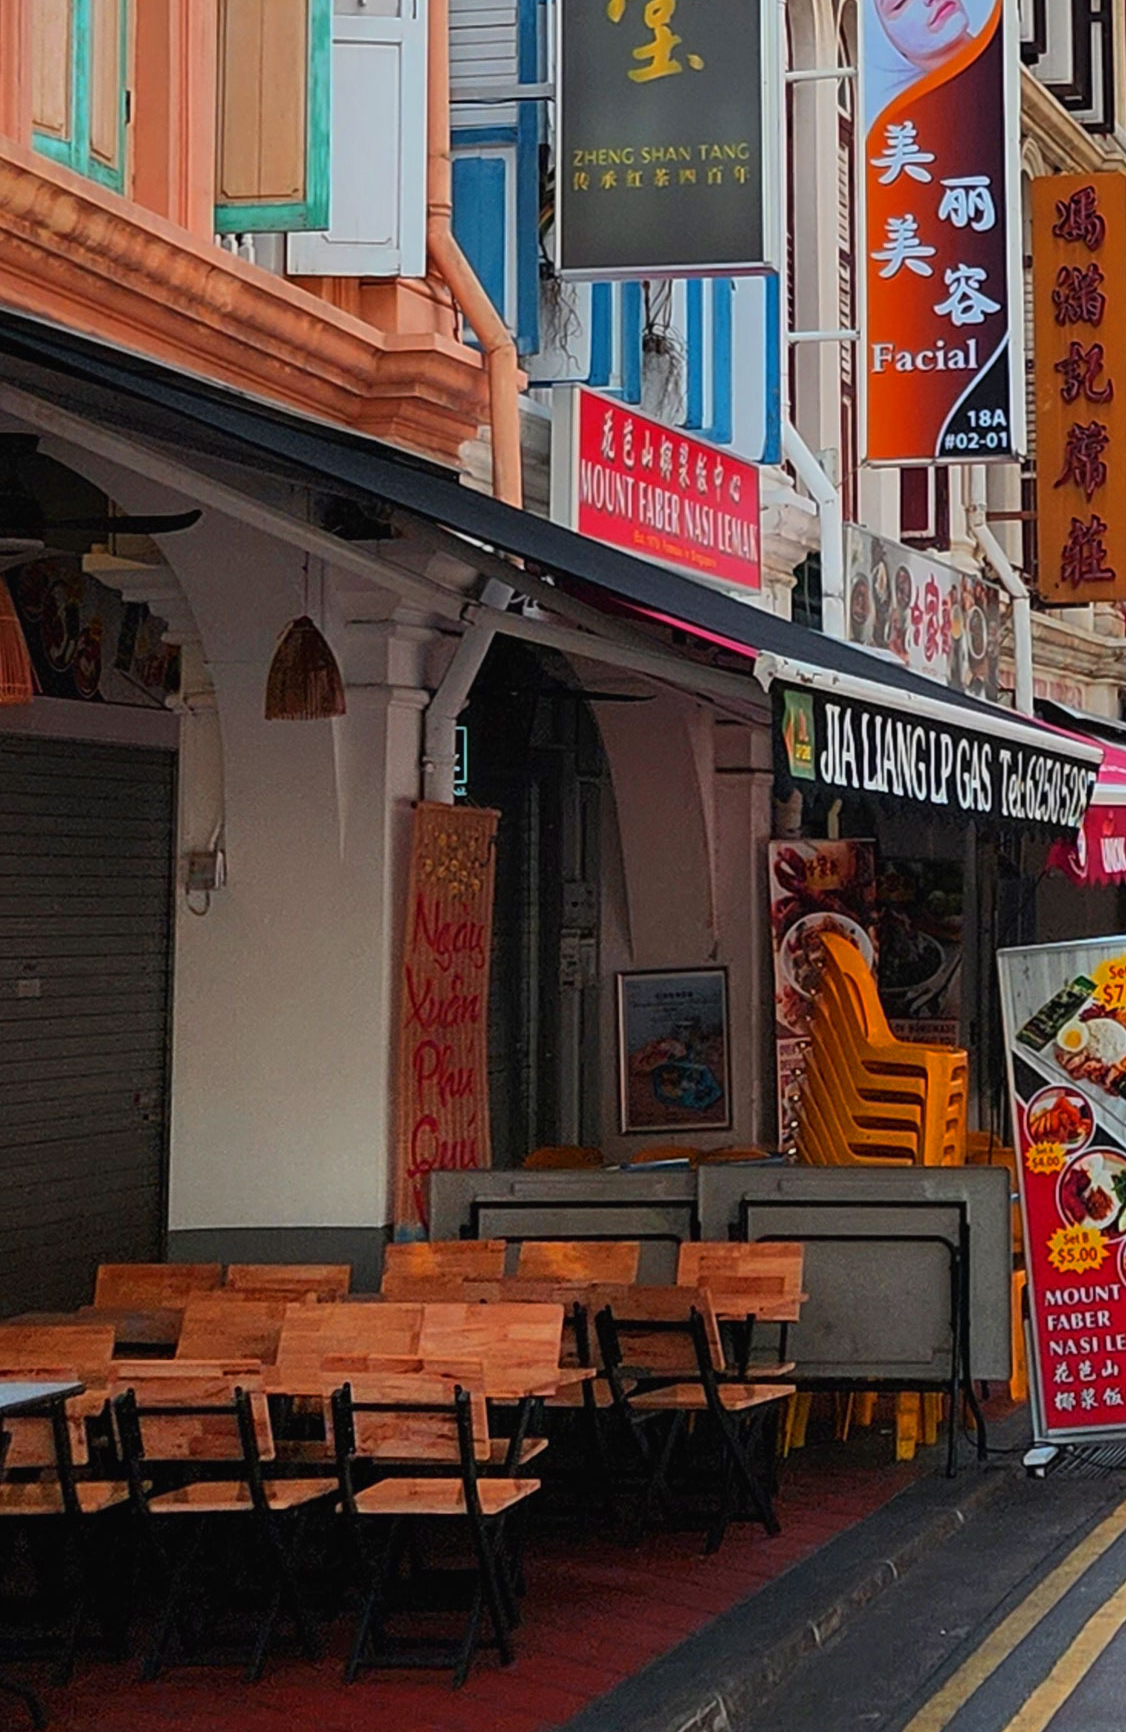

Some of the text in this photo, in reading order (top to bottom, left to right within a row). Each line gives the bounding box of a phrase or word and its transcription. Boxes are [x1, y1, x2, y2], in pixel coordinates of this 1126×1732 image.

[573, 143, 749, 166] ZHENG SHAN TANG
[871, 338, 978, 374] Facial
[967, 409, 1007, 427] 18A
[944, 432, 1008, 450] #02-01
[581, 459, 635, 519] MOUNT
[639, 481, 680, 536] FABER
[685, 499, 714, 547] NASI
[718, 512, 758, 562] LEMAK
[820, 703, 859, 788] JIA
[862, 712, 926, 801] LIANG
[930, 731, 953, 805] LP
[957, 738, 992, 812] GAS
[1063, 1232, 1090, 1245] Set B
[1057, 1248, 1098, 1264] $5.00
[1045, 1284, 1121, 1307] MOUNT
[1048, 1310, 1111, 1331] FABER
[1050, 1337, 1098, 1356] NASI
